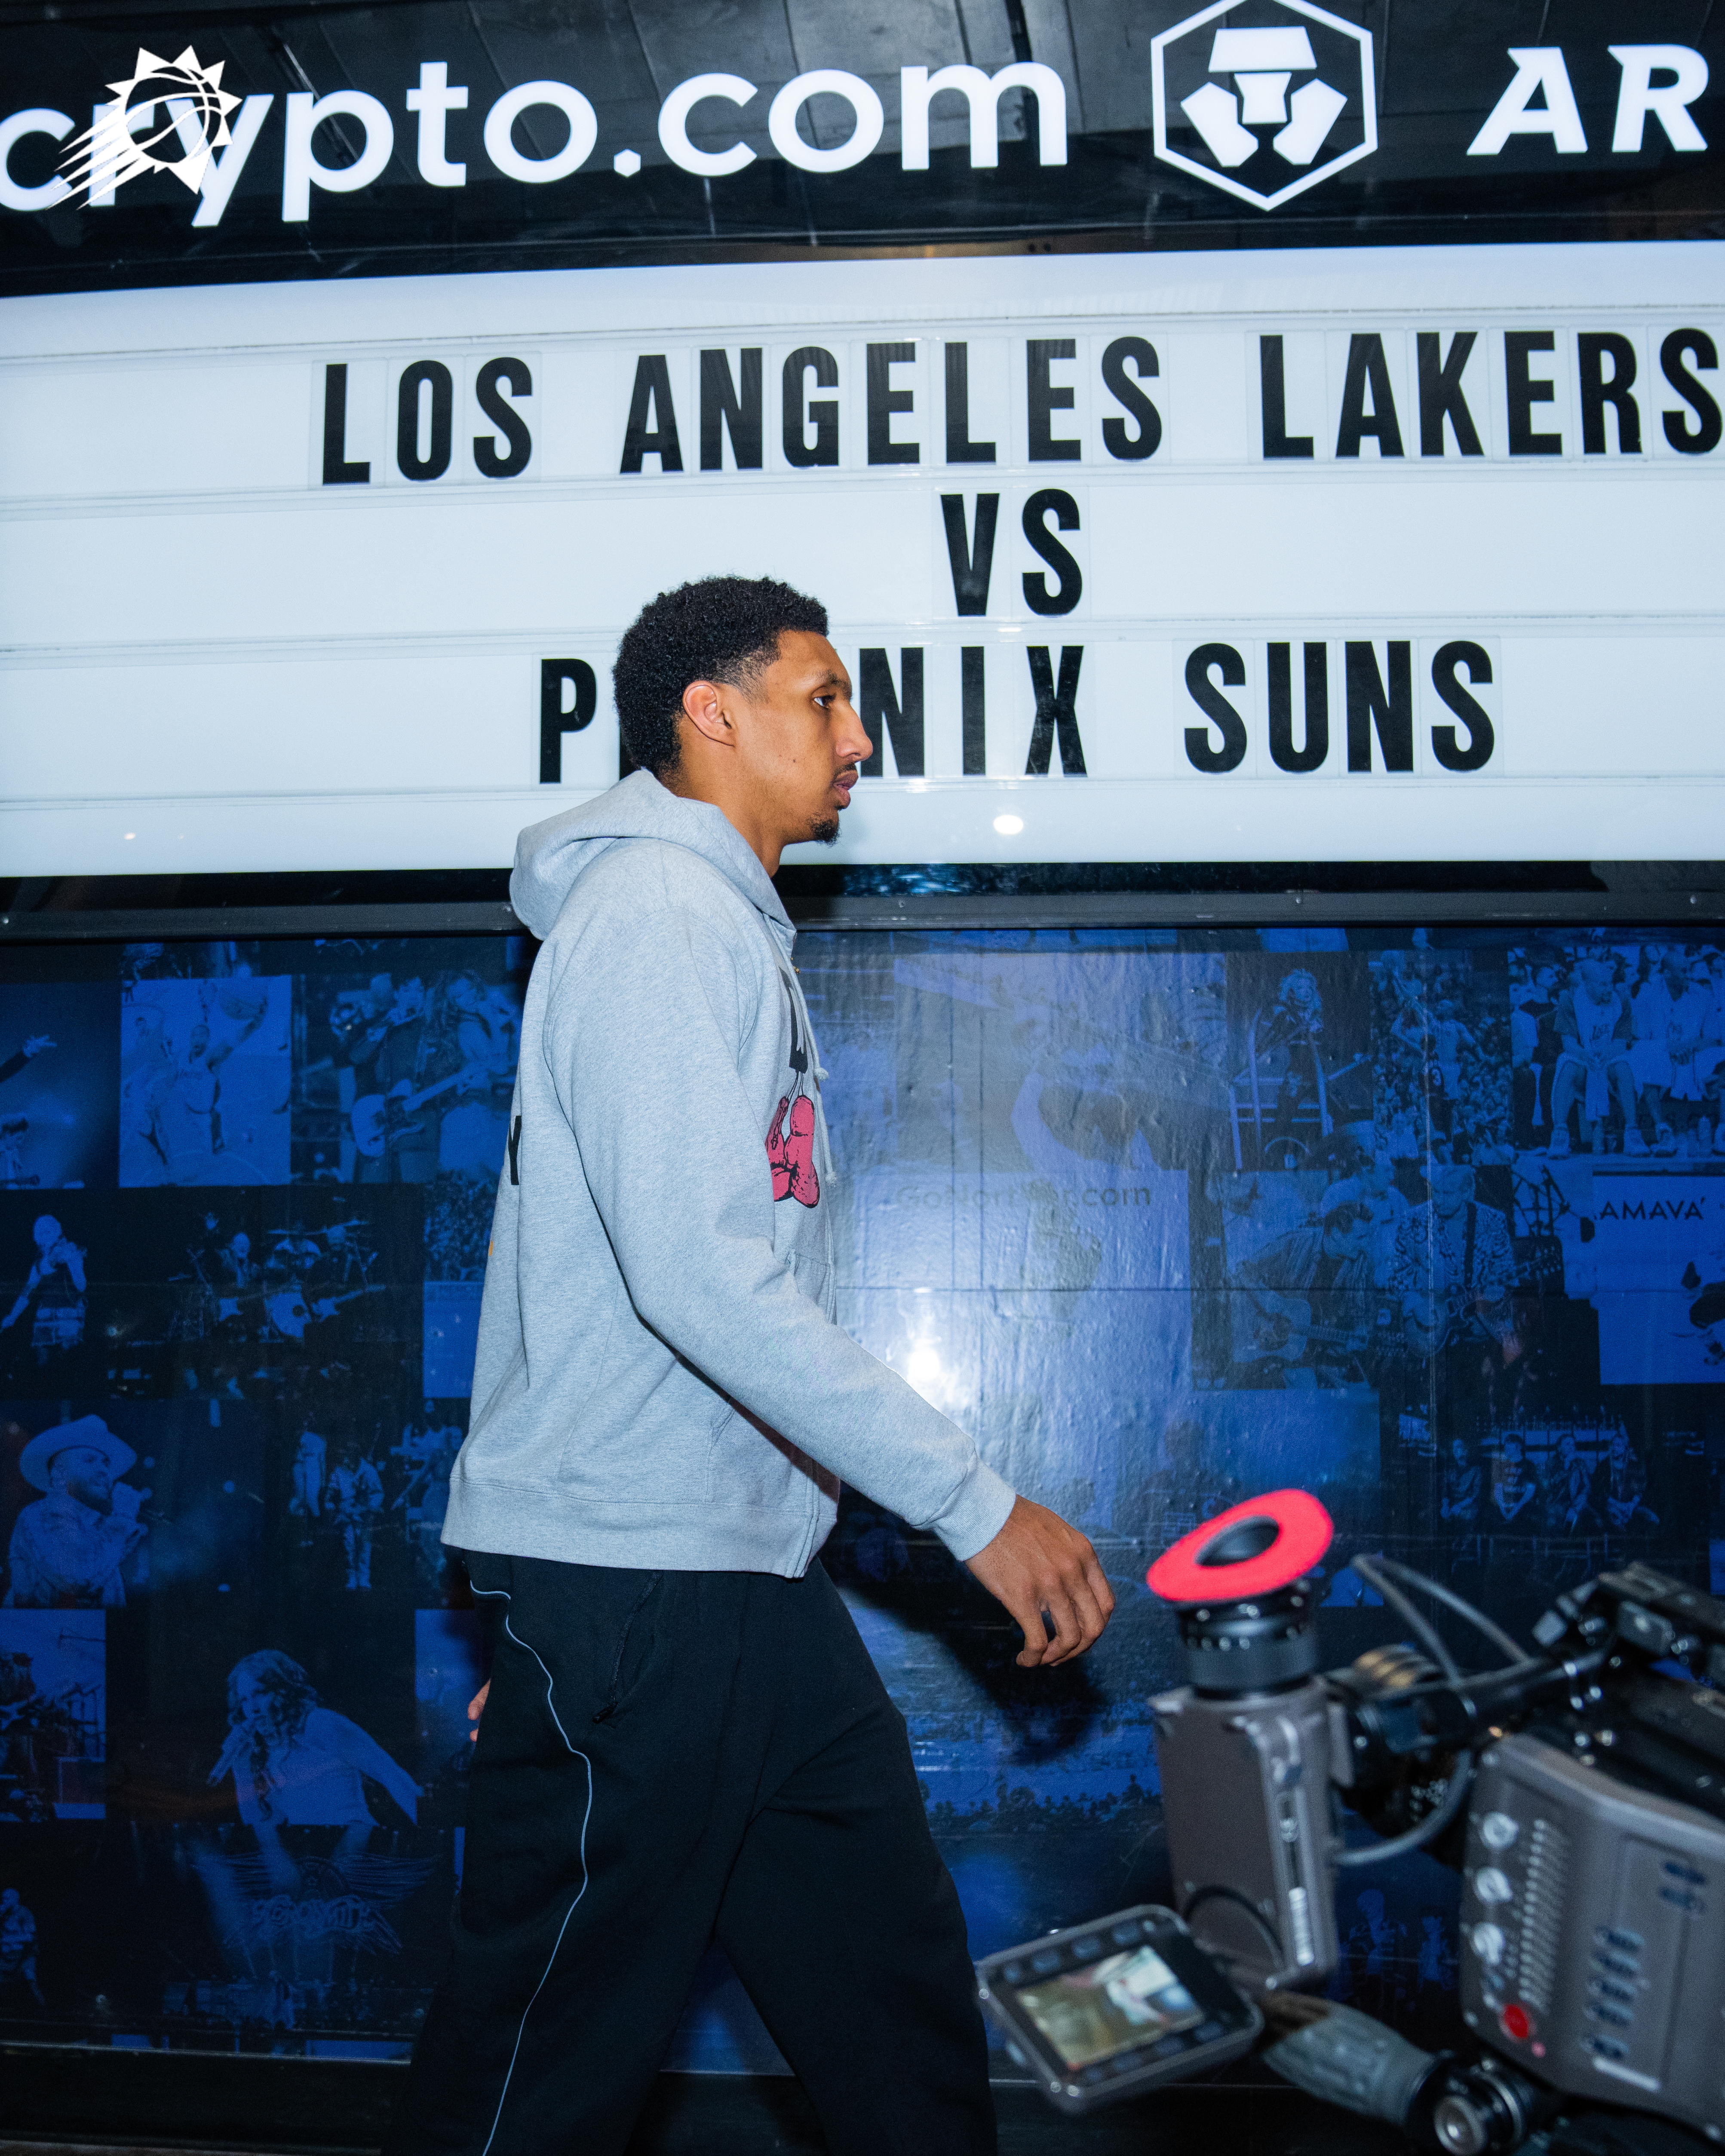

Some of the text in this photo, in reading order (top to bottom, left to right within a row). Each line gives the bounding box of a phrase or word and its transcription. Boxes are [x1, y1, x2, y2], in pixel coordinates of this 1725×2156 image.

[0, 46, 1708, 227] crypto.com AR
[323, 328, 1723, 485] LOS ANGELES LAKERS
[940, 489, 1083, 617] VS
[540, 641, 1495, 784] PNIX SUNS
